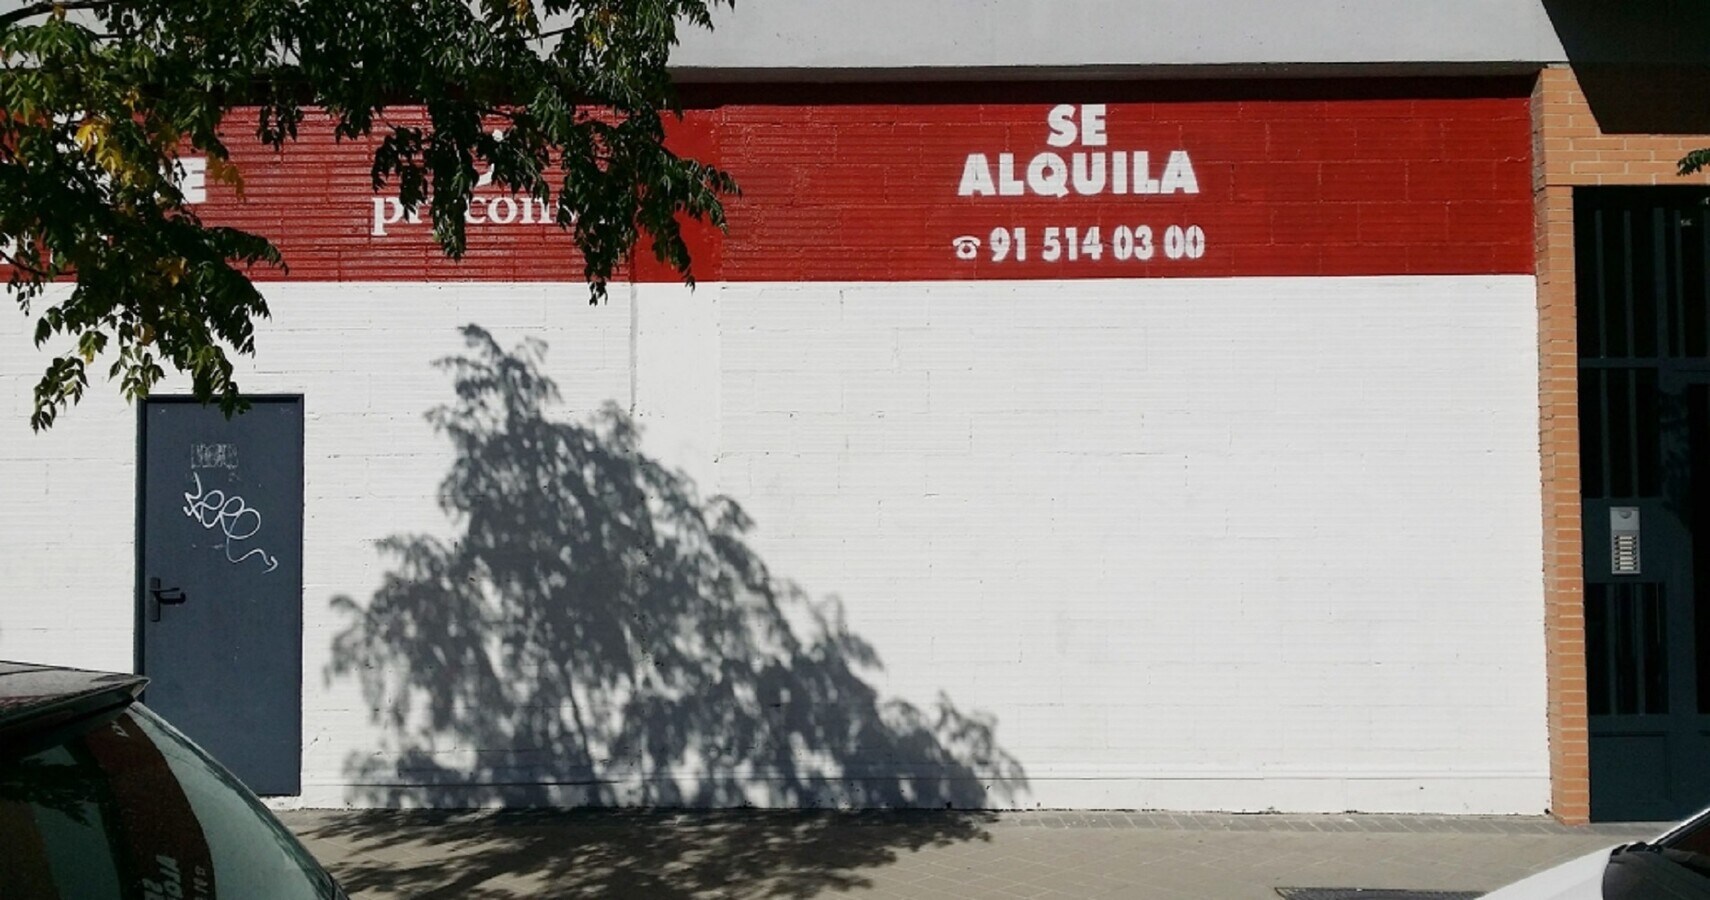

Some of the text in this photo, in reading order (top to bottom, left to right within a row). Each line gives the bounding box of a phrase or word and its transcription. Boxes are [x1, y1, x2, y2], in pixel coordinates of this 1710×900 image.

[1047, 104, 1107, 147] SE
[958, 151, 1199, 198] ALQUILA
[990, 225, 1204, 261] 91 514 03 00
